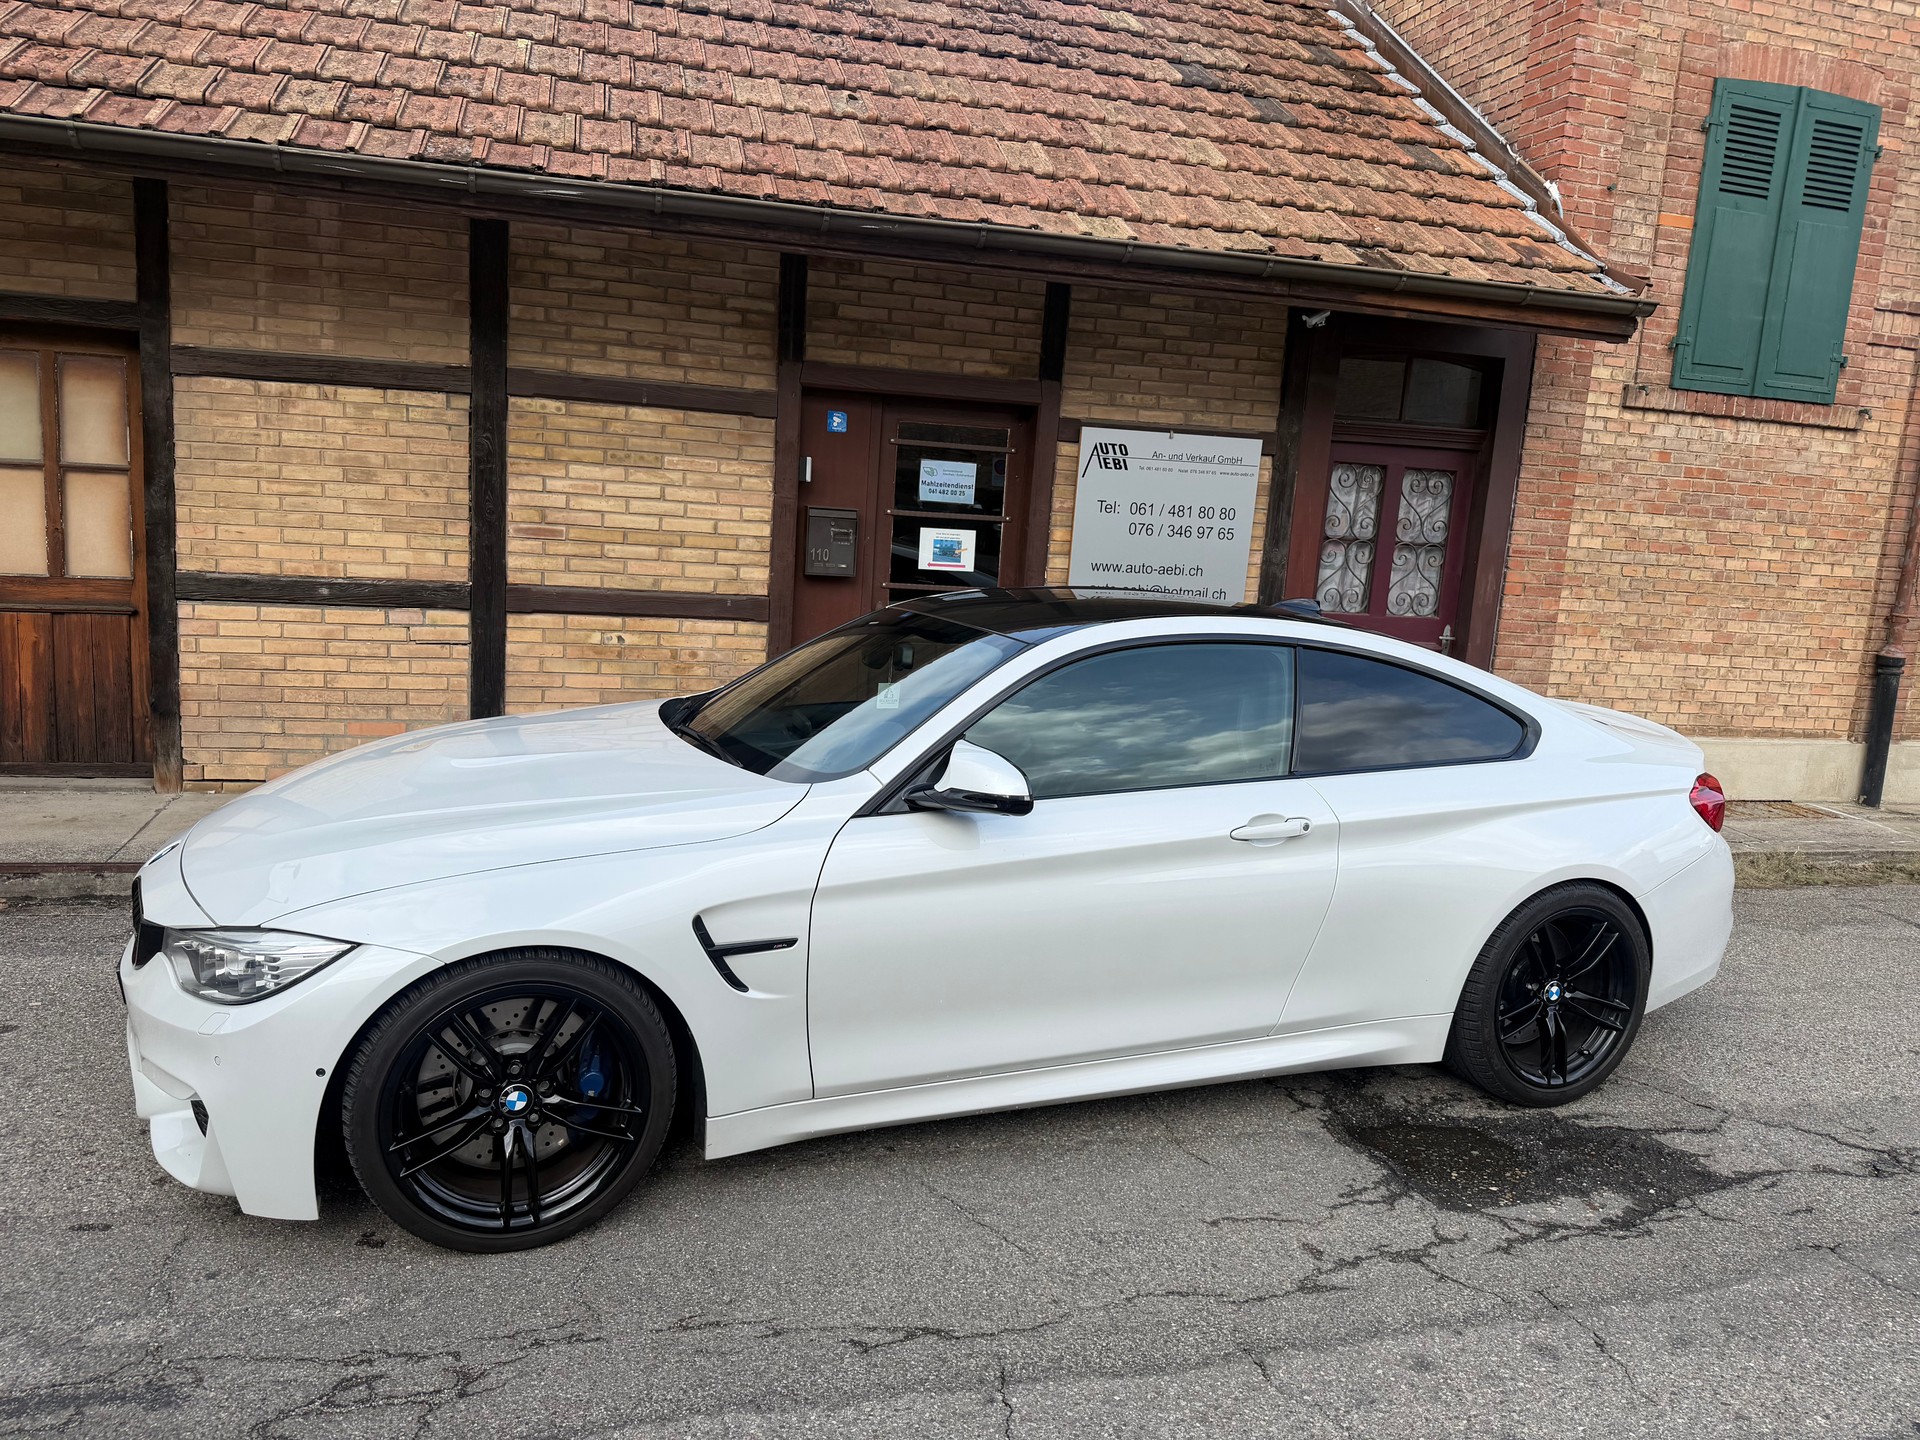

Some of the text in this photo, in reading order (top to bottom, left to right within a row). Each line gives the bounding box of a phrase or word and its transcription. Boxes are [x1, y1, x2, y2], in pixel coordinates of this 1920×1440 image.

[1151, 450, 1243, 465] An- und Verkauf GmbH
[920, 480, 974, 490] Mahlzeitendienst
[1097, 499, 1236, 521] Tel: 061 / 481 80 80
[1128, 522, 1235, 541] 076 / 346 97 65
[810, 547, 830, 561] 110
[1090, 562, 1204, 577] www.auto-aebi.ch
[1090, 584, 1227, 600] bi@hotmail.ch
